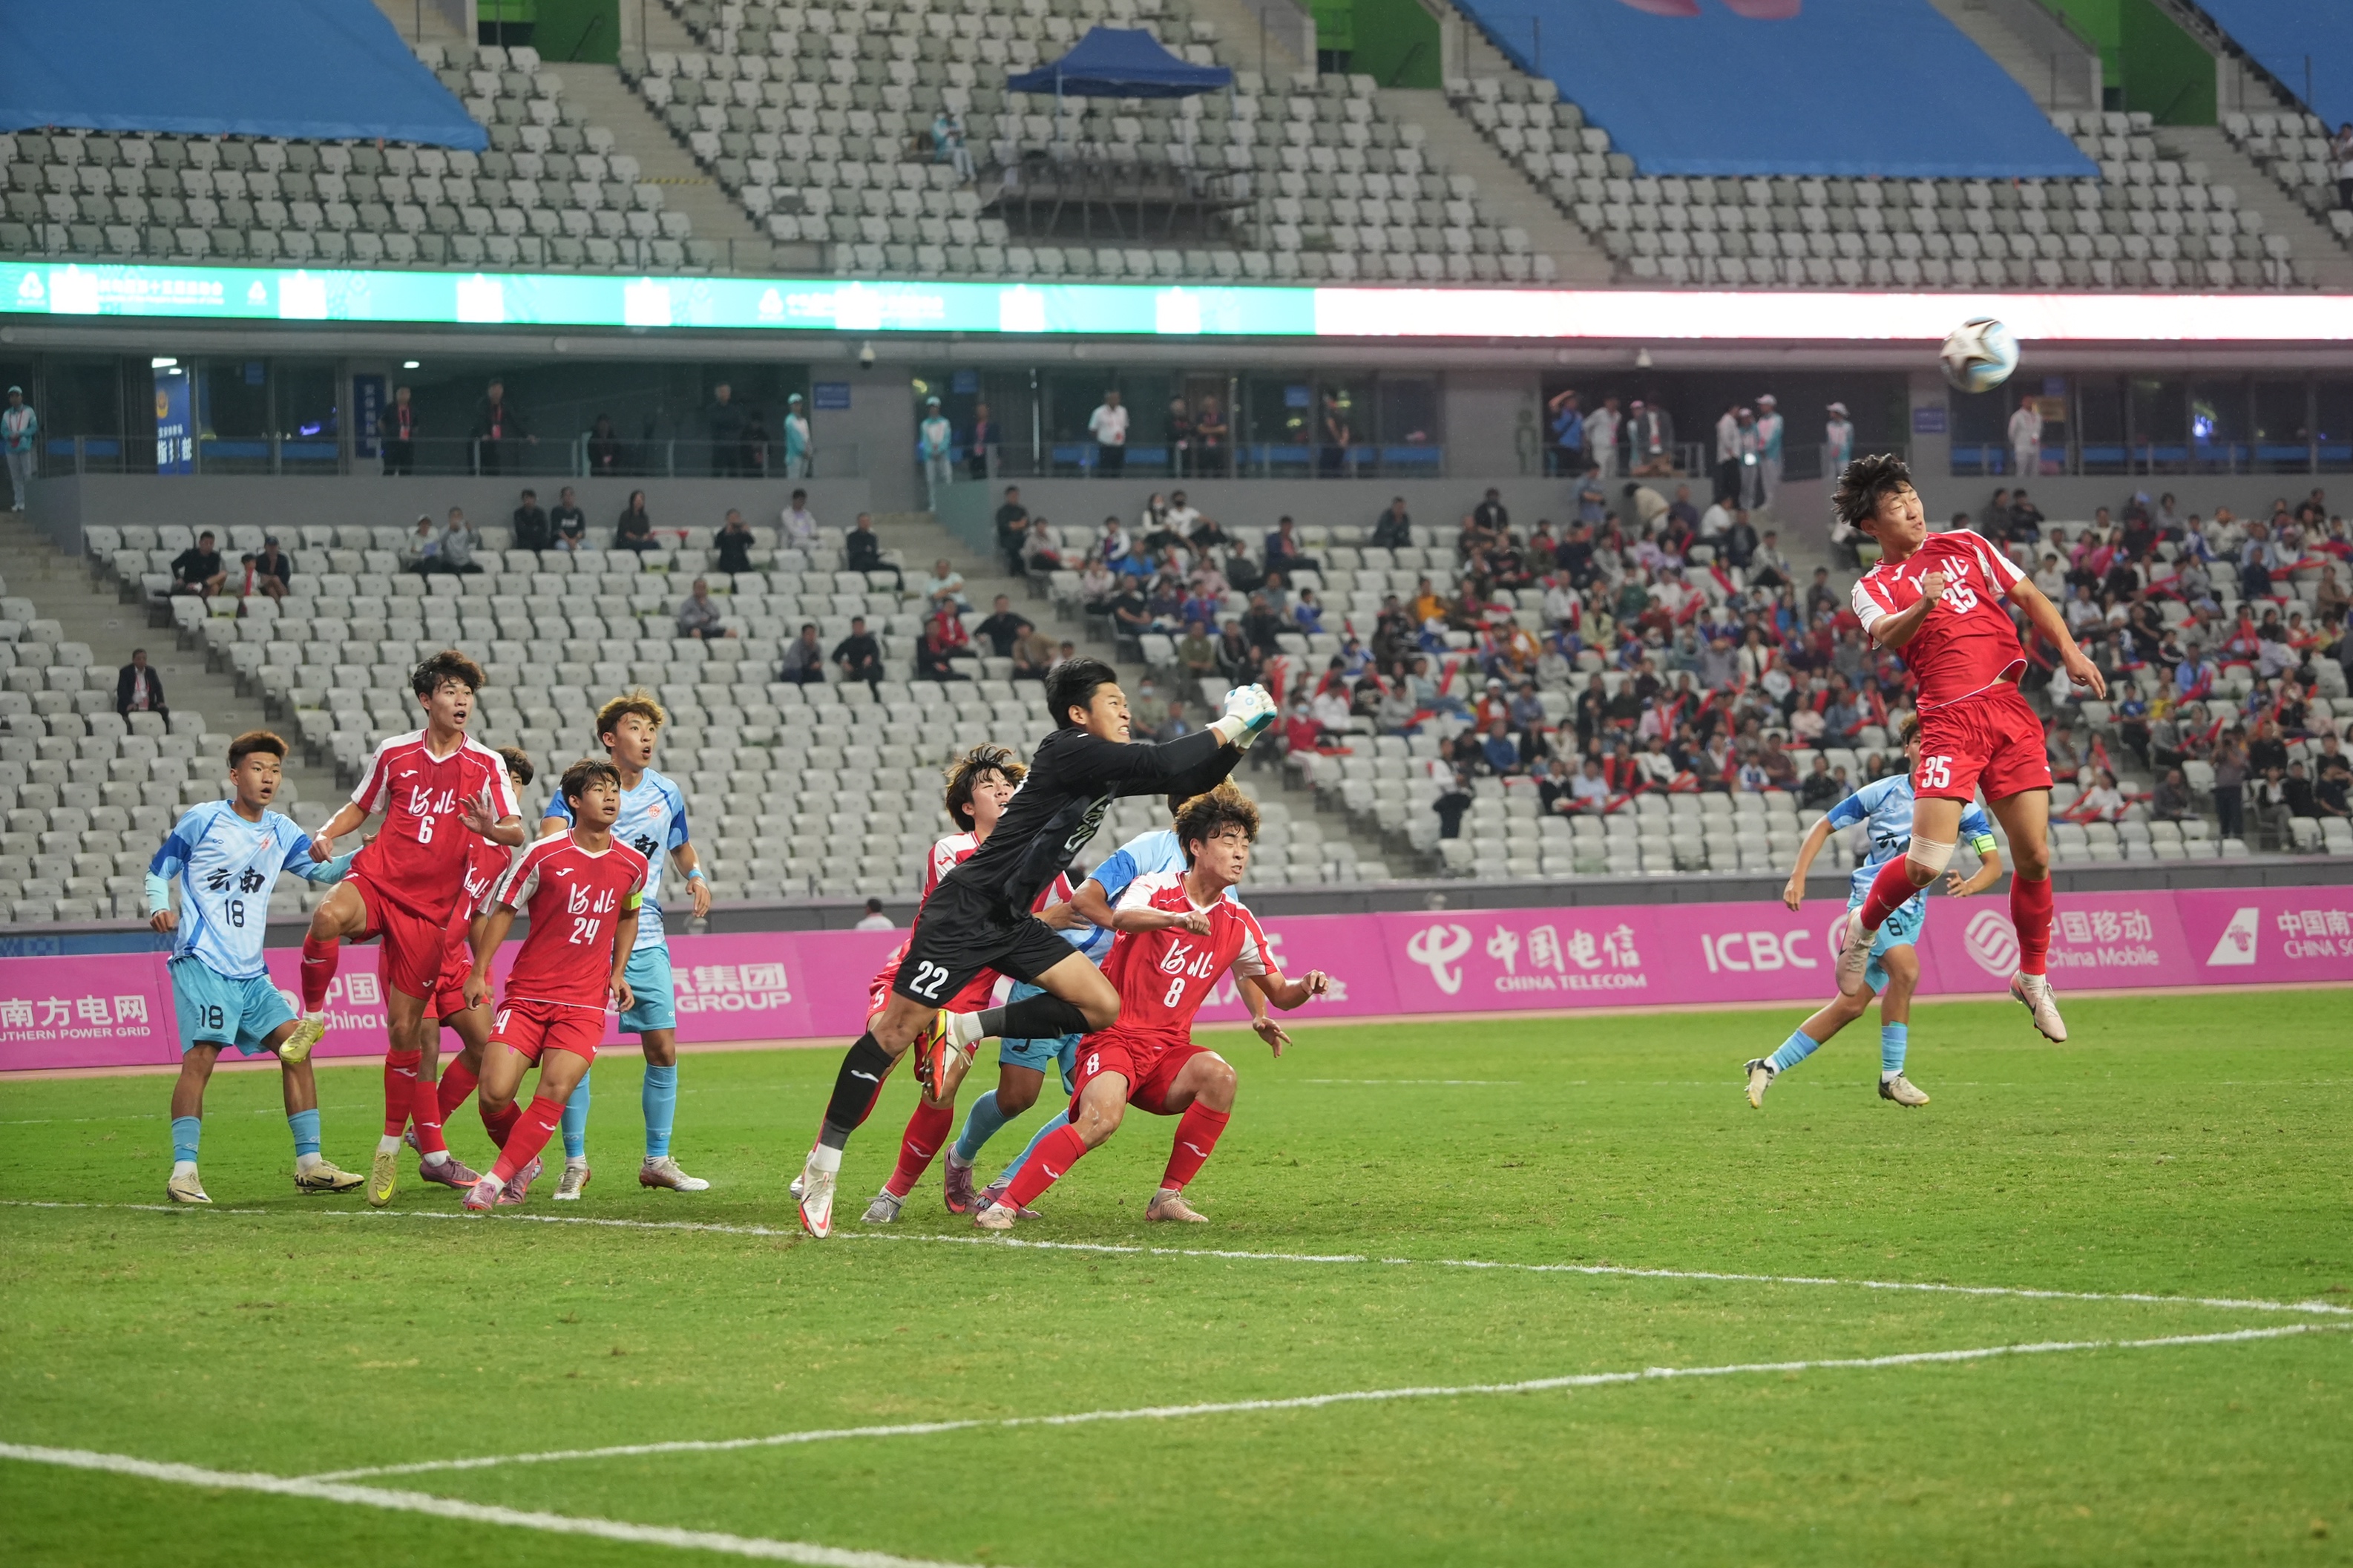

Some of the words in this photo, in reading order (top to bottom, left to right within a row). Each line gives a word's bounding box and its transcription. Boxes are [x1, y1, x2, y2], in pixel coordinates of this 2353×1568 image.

[1942, 578, 1978, 614] 35
[1921, 755, 1952, 788] 35
[418, 816, 435, 844] 6
[207, 865, 265, 893] 云南
[568, 882, 615, 915] 河北
[225, 899, 245, 928] 18
[2277, 908, 2353, 938] 中国南
[568, 917, 600, 945] 24
[1160, 938, 1213, 979] 河北
[1486, 923, 1641, 974] 中国电信
[1701, 929, 1817, 974] ICBC
[2046, 947, 2097, 968] China
[2096, 944, 2159, 966] Mobile
[2283, 939, 2337, 959] CHINA
[909, 960, 949, 1000] 22
[1164, 977, 1186, 1008] 8
[1494, 975, 1557, 992] CHINA
[1558, 973, 1647, 990] TELECOM
[0, 994, 148, 1028] 南方电网
[676, 991, 792, 1012] GROUP
[200, 1004, 224, 1030] 18
[490, 1008, 512, 1034] 4
[60, 1027, 113, 1039] POWER
[116, 1026, 151, 1037] GRID
[1086, 1052, 1100, 1076] 8
